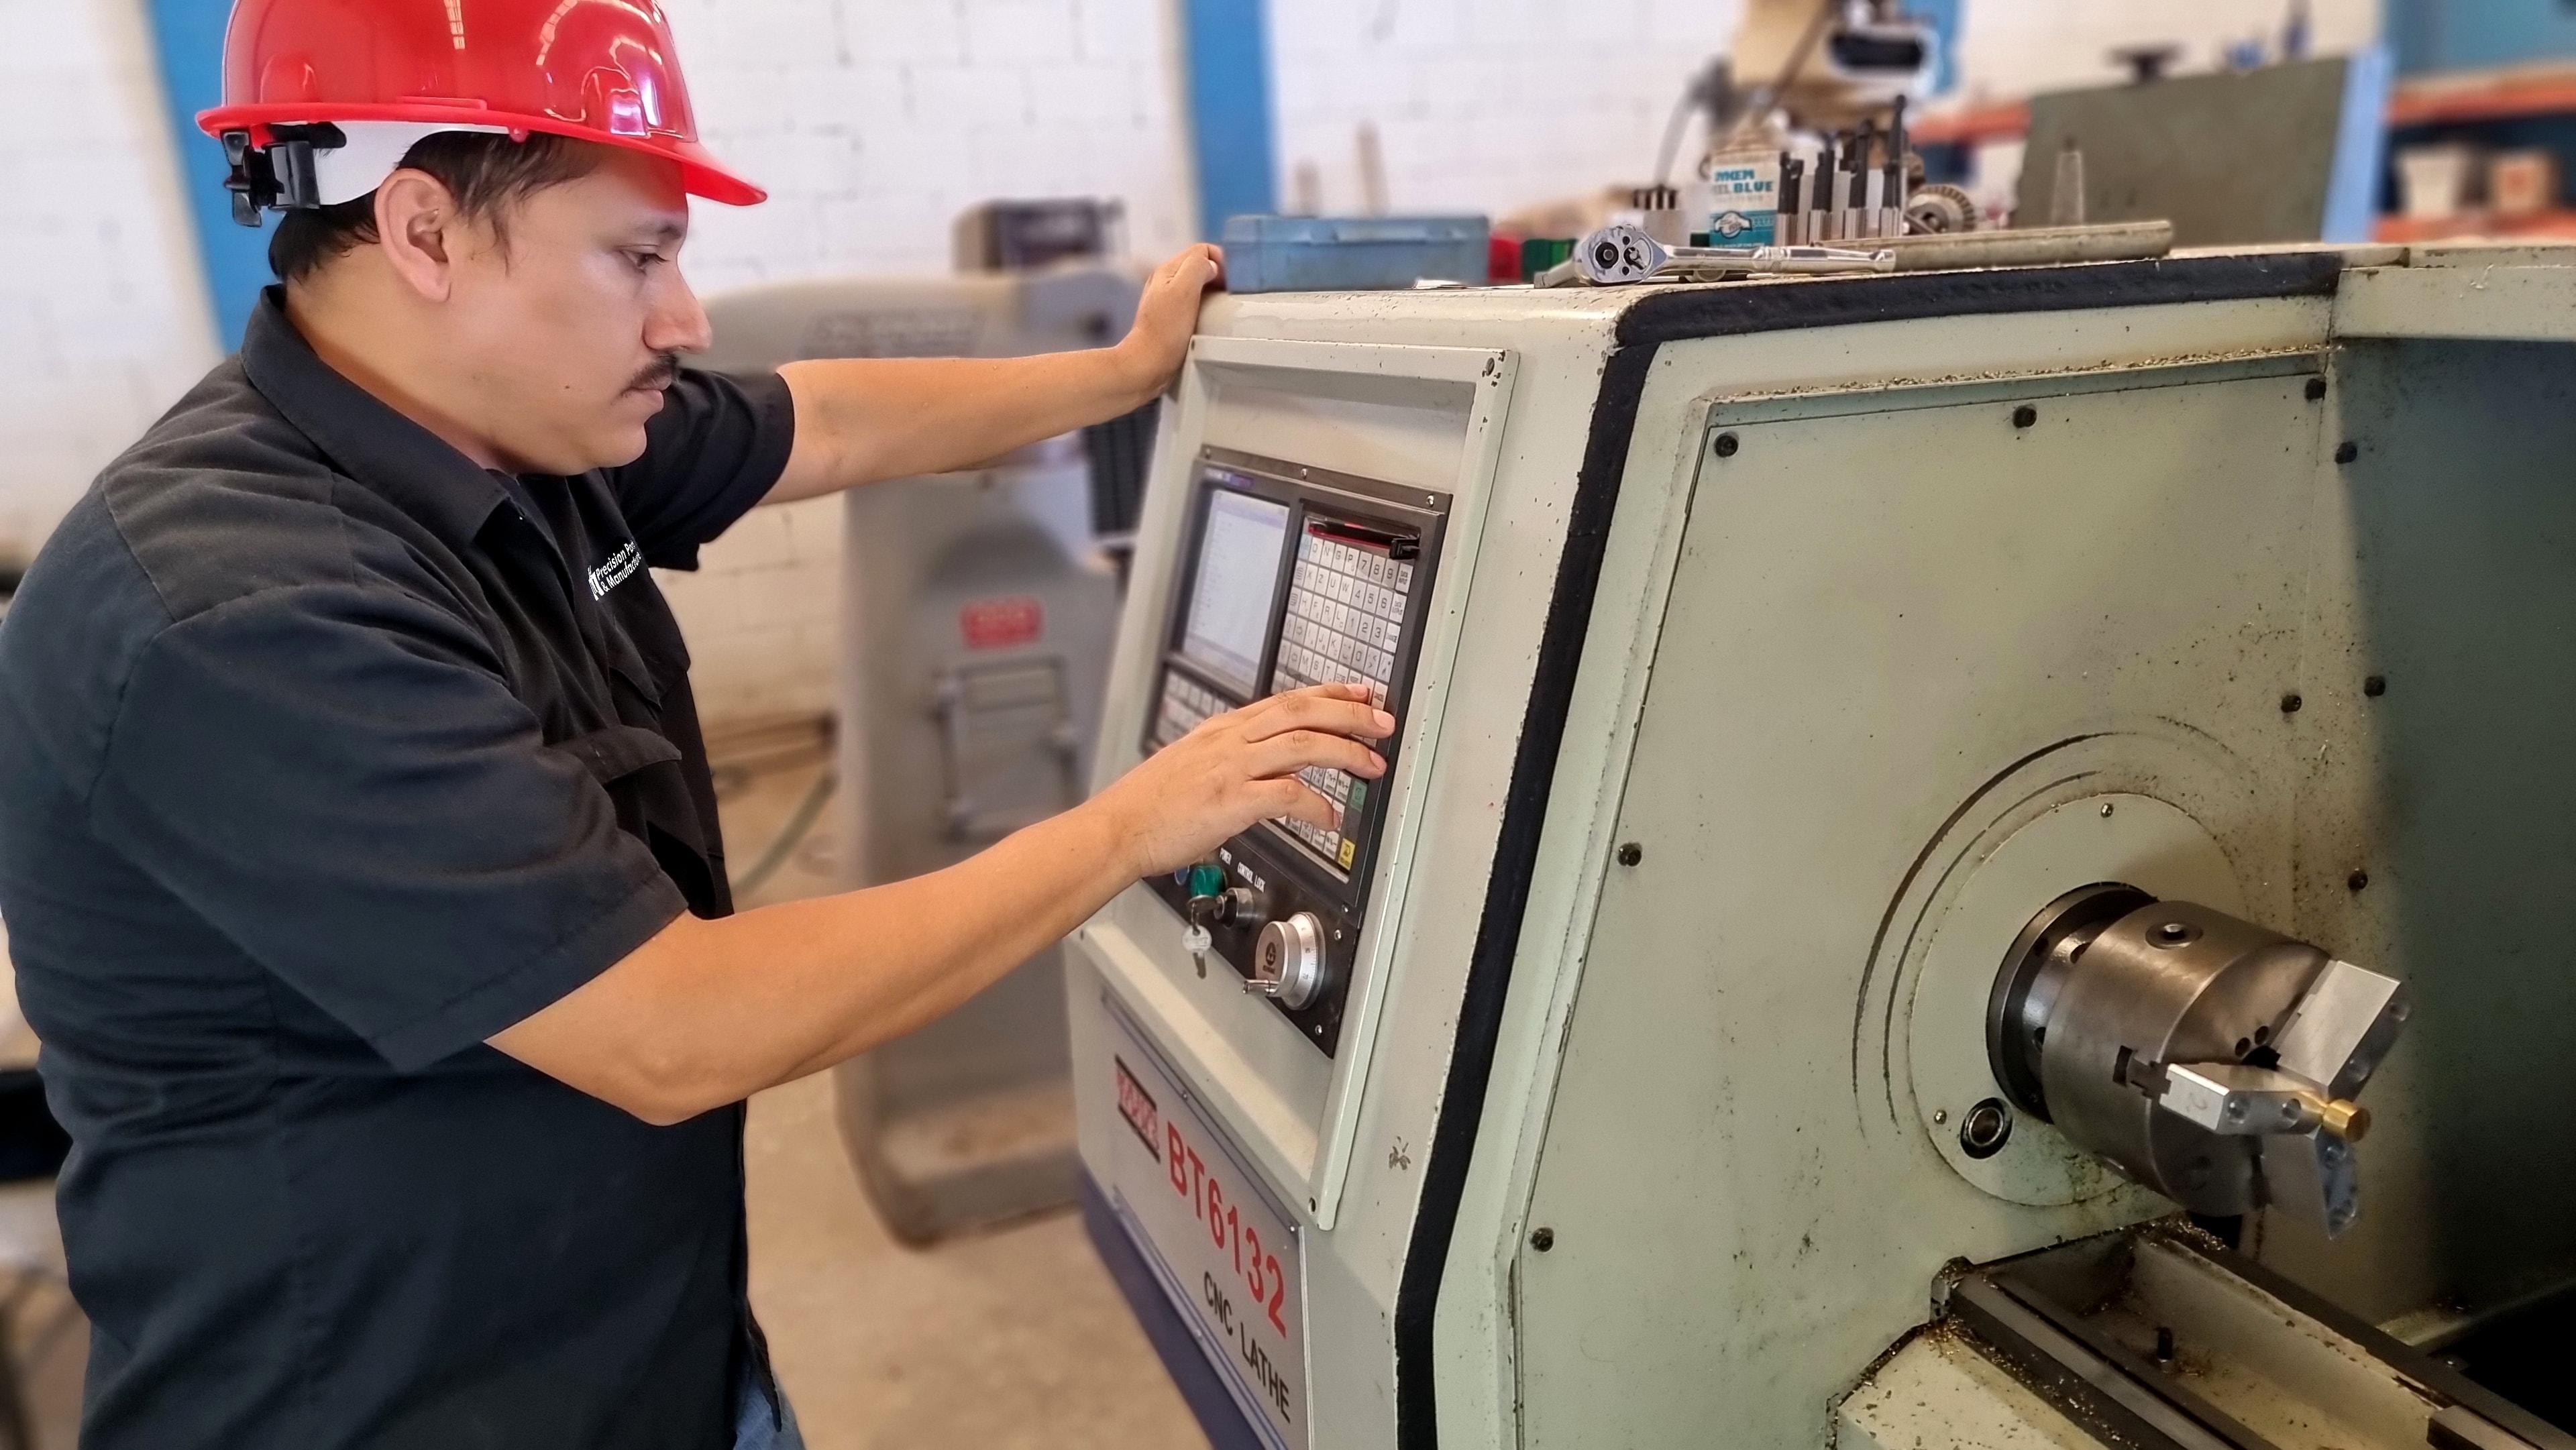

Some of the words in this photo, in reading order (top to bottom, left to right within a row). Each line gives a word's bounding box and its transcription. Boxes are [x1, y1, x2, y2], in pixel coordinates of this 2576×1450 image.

[1733, 181, 1773, 193] BLUE
[1324, 547, 1330, 557] N
[1336, 551, 1342, 560] G
[1348, 554, 1354, 562] P
[596, 550, 627, 581] Precision
[1362, 560, 1367, 570] 7
[1374, 564, 1380, 575] 8
[1307, 570, 1313, 579] X
[1387, 568, 1393, 579] 9
[601, 581, 610, 592] &
[1330, 579, 1336, 588] U
[1342, 581, 1349, 593] W
[1355, 590, 1360, 599] 4
[1367, 594, 1374, 604] 5
[1302, 598, 1307, 606] H
[1381, 598, 1387, 608] 6
[1324, 606, 1330, 614] R
[1336, 610, 1340, 620] L
[1350, 618, 1354, 628] 1
[1362, 622, 1368, 634] 2
[1375, 627, 1381, 638] 3
[1319, 633, 1324, 643] J
[1331, 638, 1336, 648] K
[1303, 655, 1309, 665] M
[1356, 651, 1362, 661] 0
[1313, 660, 1319, 670] S
[1326, 665, 1330, 675] T
[1220, 847, 1232, 865] POWER
[1238, 862, 1253, 884] CONTROL
[1254, 875, 1266, 893] LOCK
[1167, 1121, 1287, 1339] BT6132
[1204, 1271, 1234, 1337] CNC
[1240, 1321, 1291, 1424] LATHE
